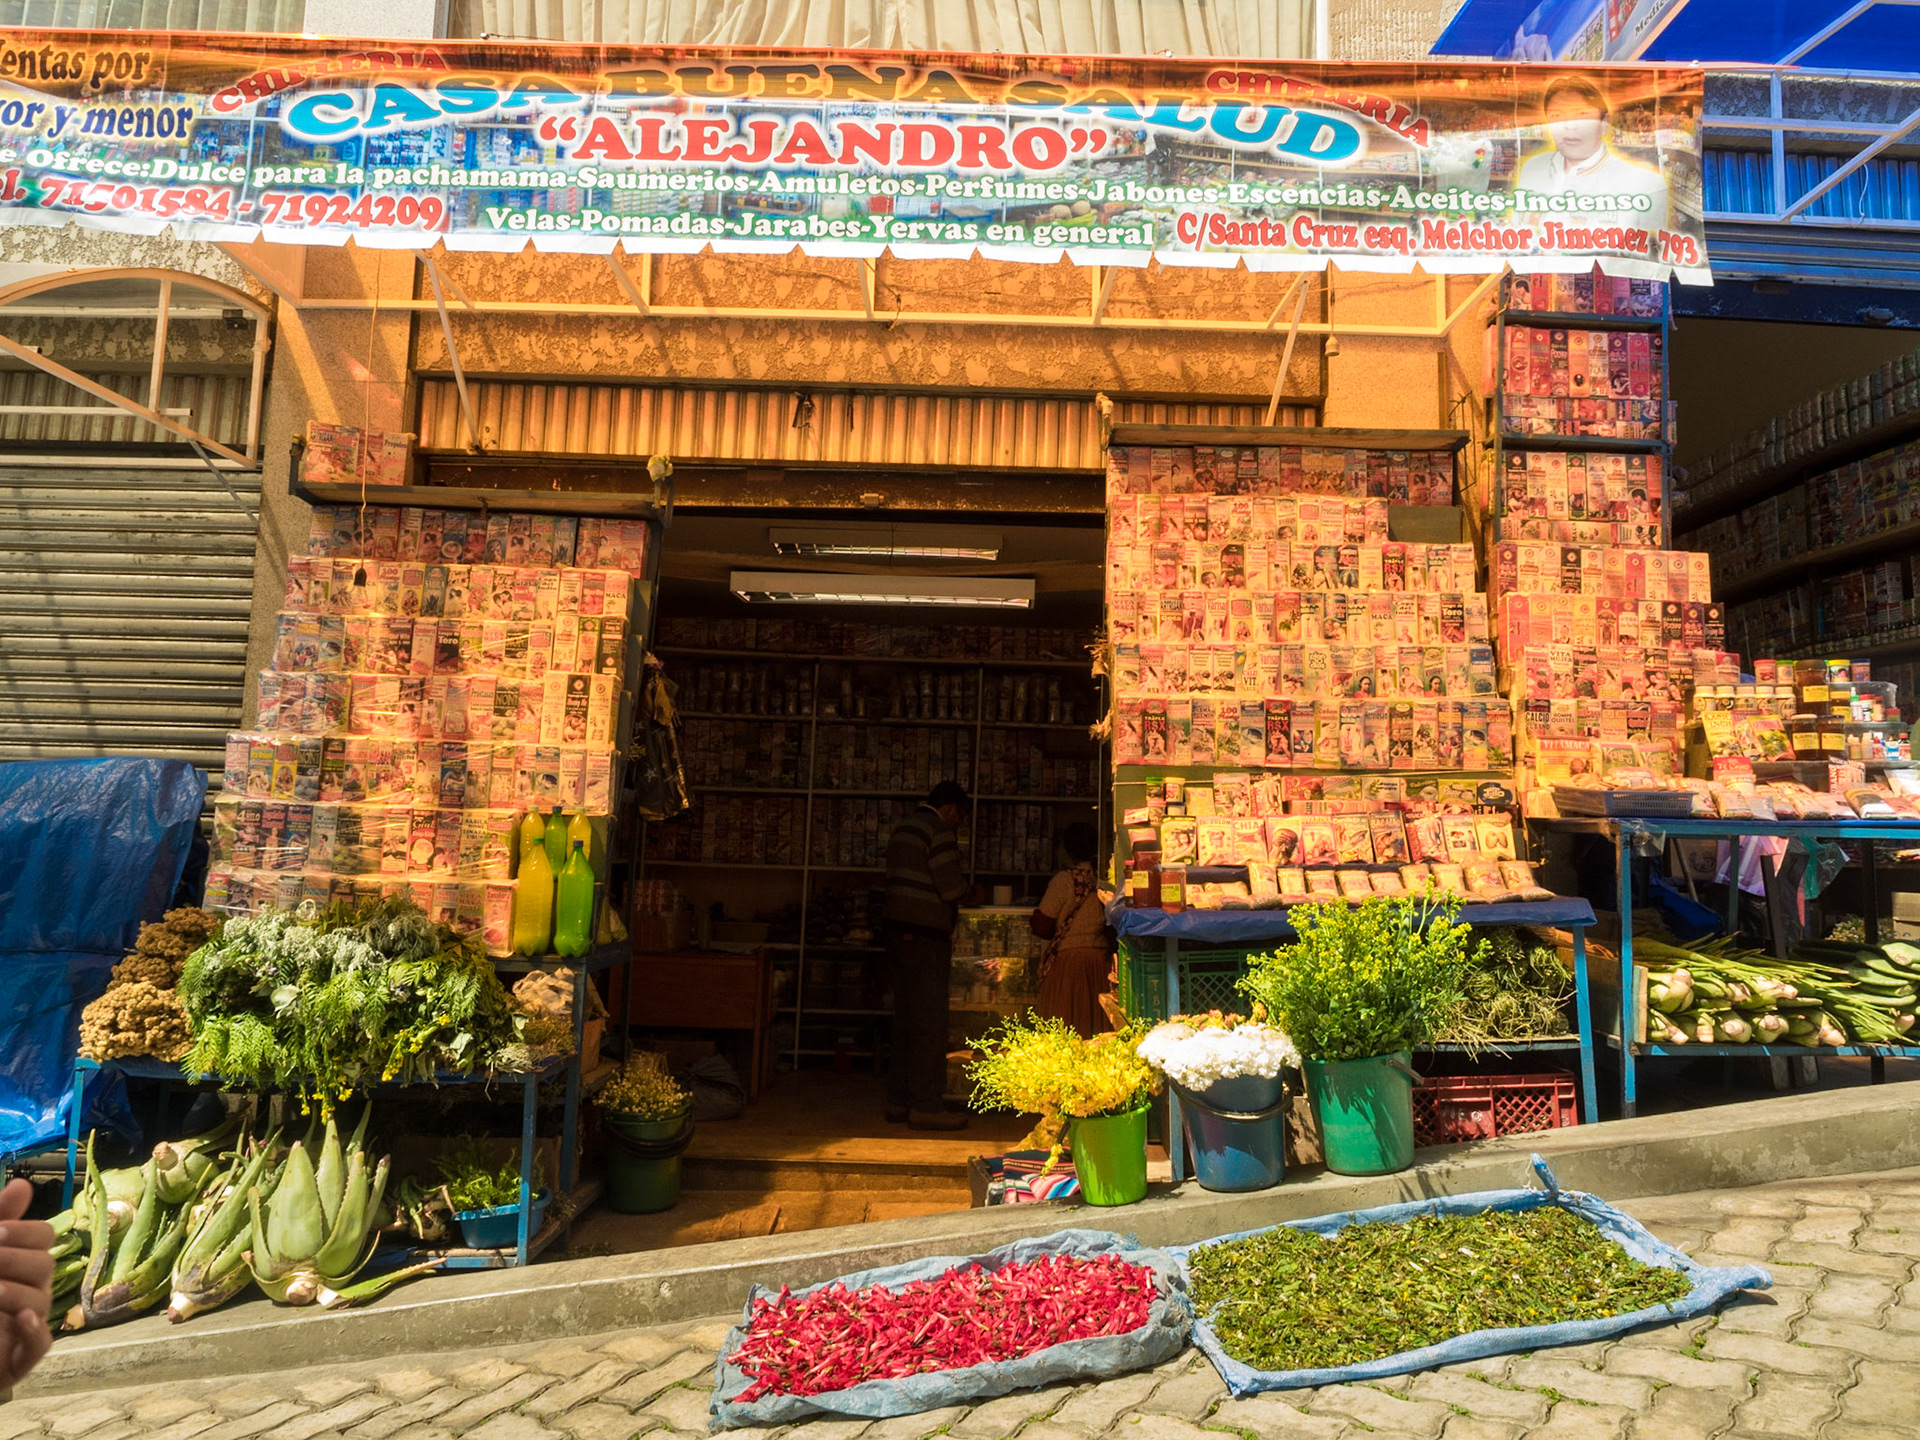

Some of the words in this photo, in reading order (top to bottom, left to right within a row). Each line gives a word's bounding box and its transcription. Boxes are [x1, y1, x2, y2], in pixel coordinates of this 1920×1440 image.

[0, 39, 86, 81] entas
[90, 51, 150, 89] por
[0, 100, 45, 129] or
[48, 106, 78, 138] y
[80, 106, 194, 139] menor
[288, 76, 583, 136] CASA
[605, 64, 981, 104] BUENA
[1005, 81, 1361, 161] SALUD
[1206, 70, 1430, 148] CHIFLERIA
[253, 164, 327, 188] para
[334, 163, 364, 185] la
[41, 177, 231, 220] 71501584
[262, 192, 445, 231] 71924209
[986, 222, 1024, 242] en
[1033, 222, 1154, 249] general
[1176, 213, 1287, 251] C/Santa
[1293, 217, 1359, 248] Cruz
[1364, 225, 1417, 256] esq.
[1423, 219, 1533, 250] Melchor
[1539, 221, 1648, 254] Jimenez
[1658, 229, 1699, 265] 793
[1443, 607, 1462, 616] Toro
[438, 636, 459, 645] Toro
[1221, 707, 1238, 715] 100
[1525, 712, 1550, 722] CALCIO
[1144, 721, 1166, 731] RSX
[1267, 721, 1289, 731] RSX
[1233, 821, 1260, 830] CHIA
